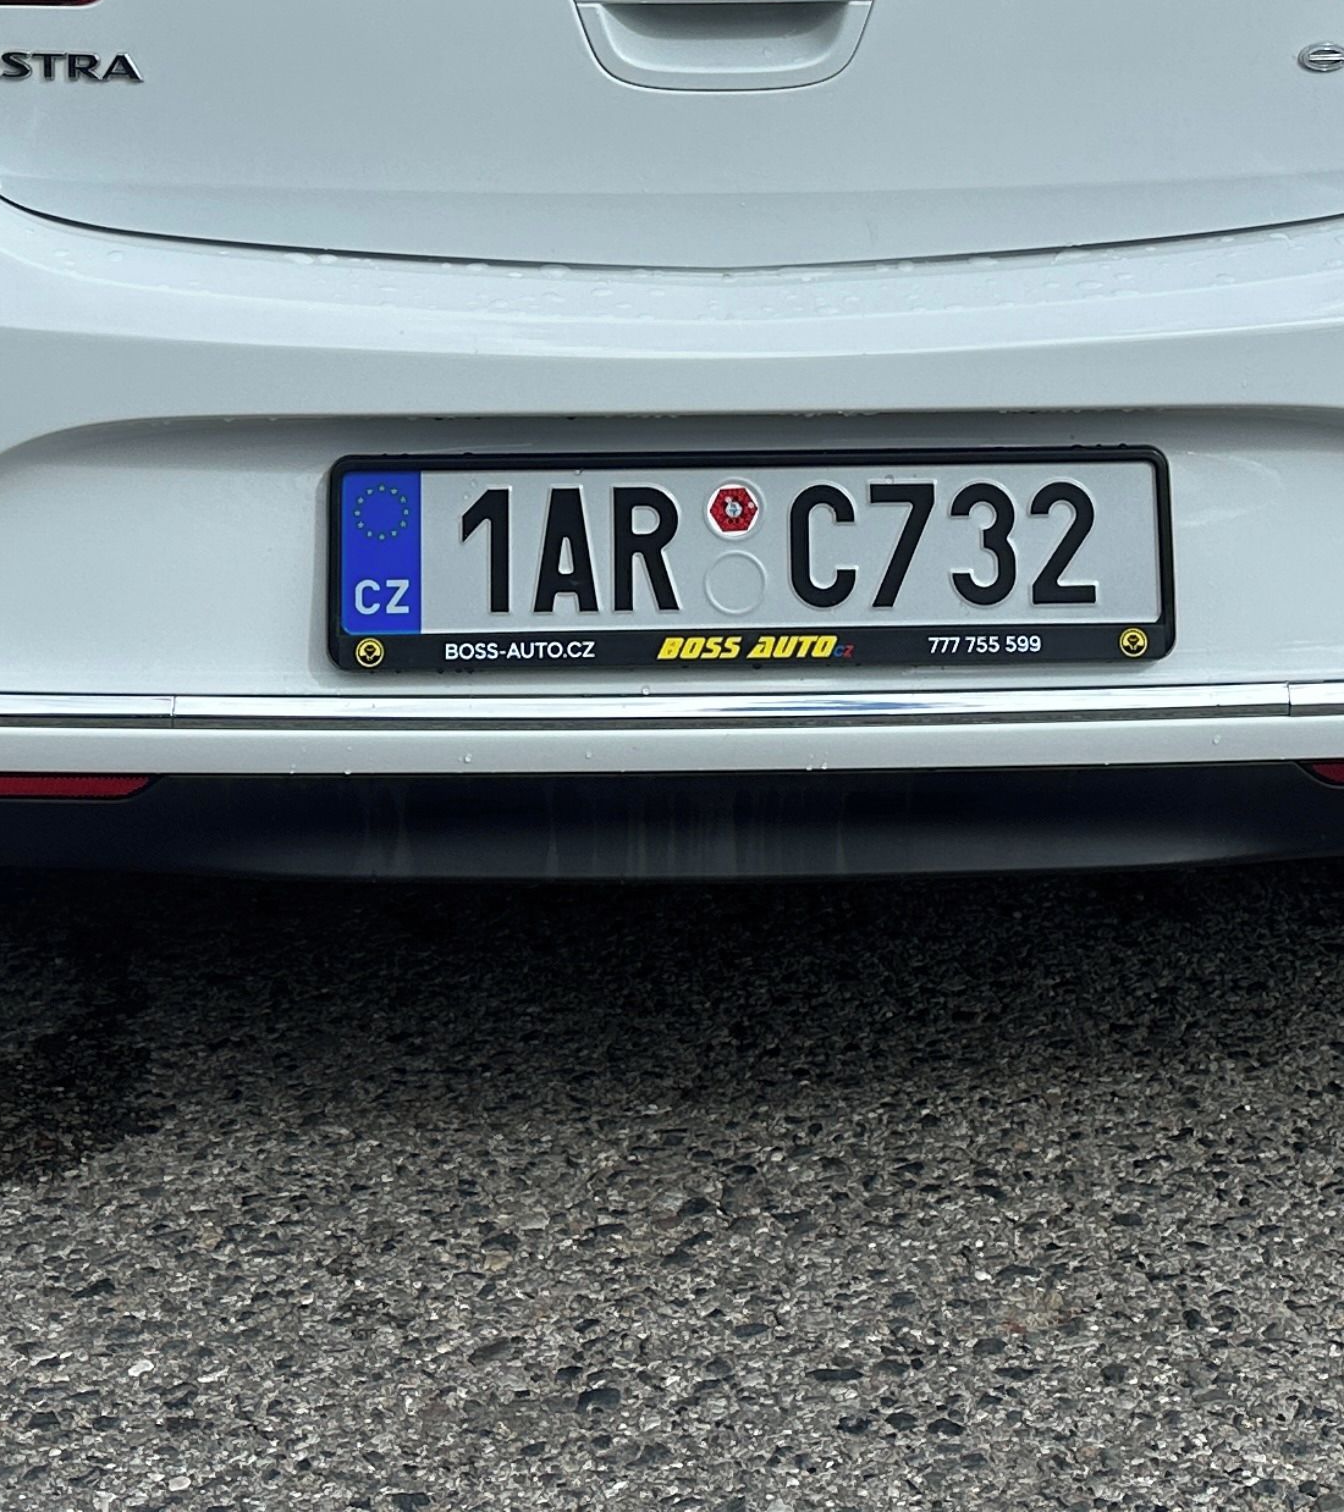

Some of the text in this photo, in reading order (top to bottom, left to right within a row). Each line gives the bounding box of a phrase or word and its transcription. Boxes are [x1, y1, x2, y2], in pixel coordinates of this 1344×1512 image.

[460, 482, 1098, 614] 1AR C732
[354, 578, 411, 615] CZ
[444, 640, 596, 660] BOSS-AUTO.CZ
[657, 636, 742, 660] BOSS
[745, 635, 839, 659] AUTO
[927, 637, 960, 654] 777
[965, 636, 1000, 653] 755
[1004, 635, 1042, 652] 599
